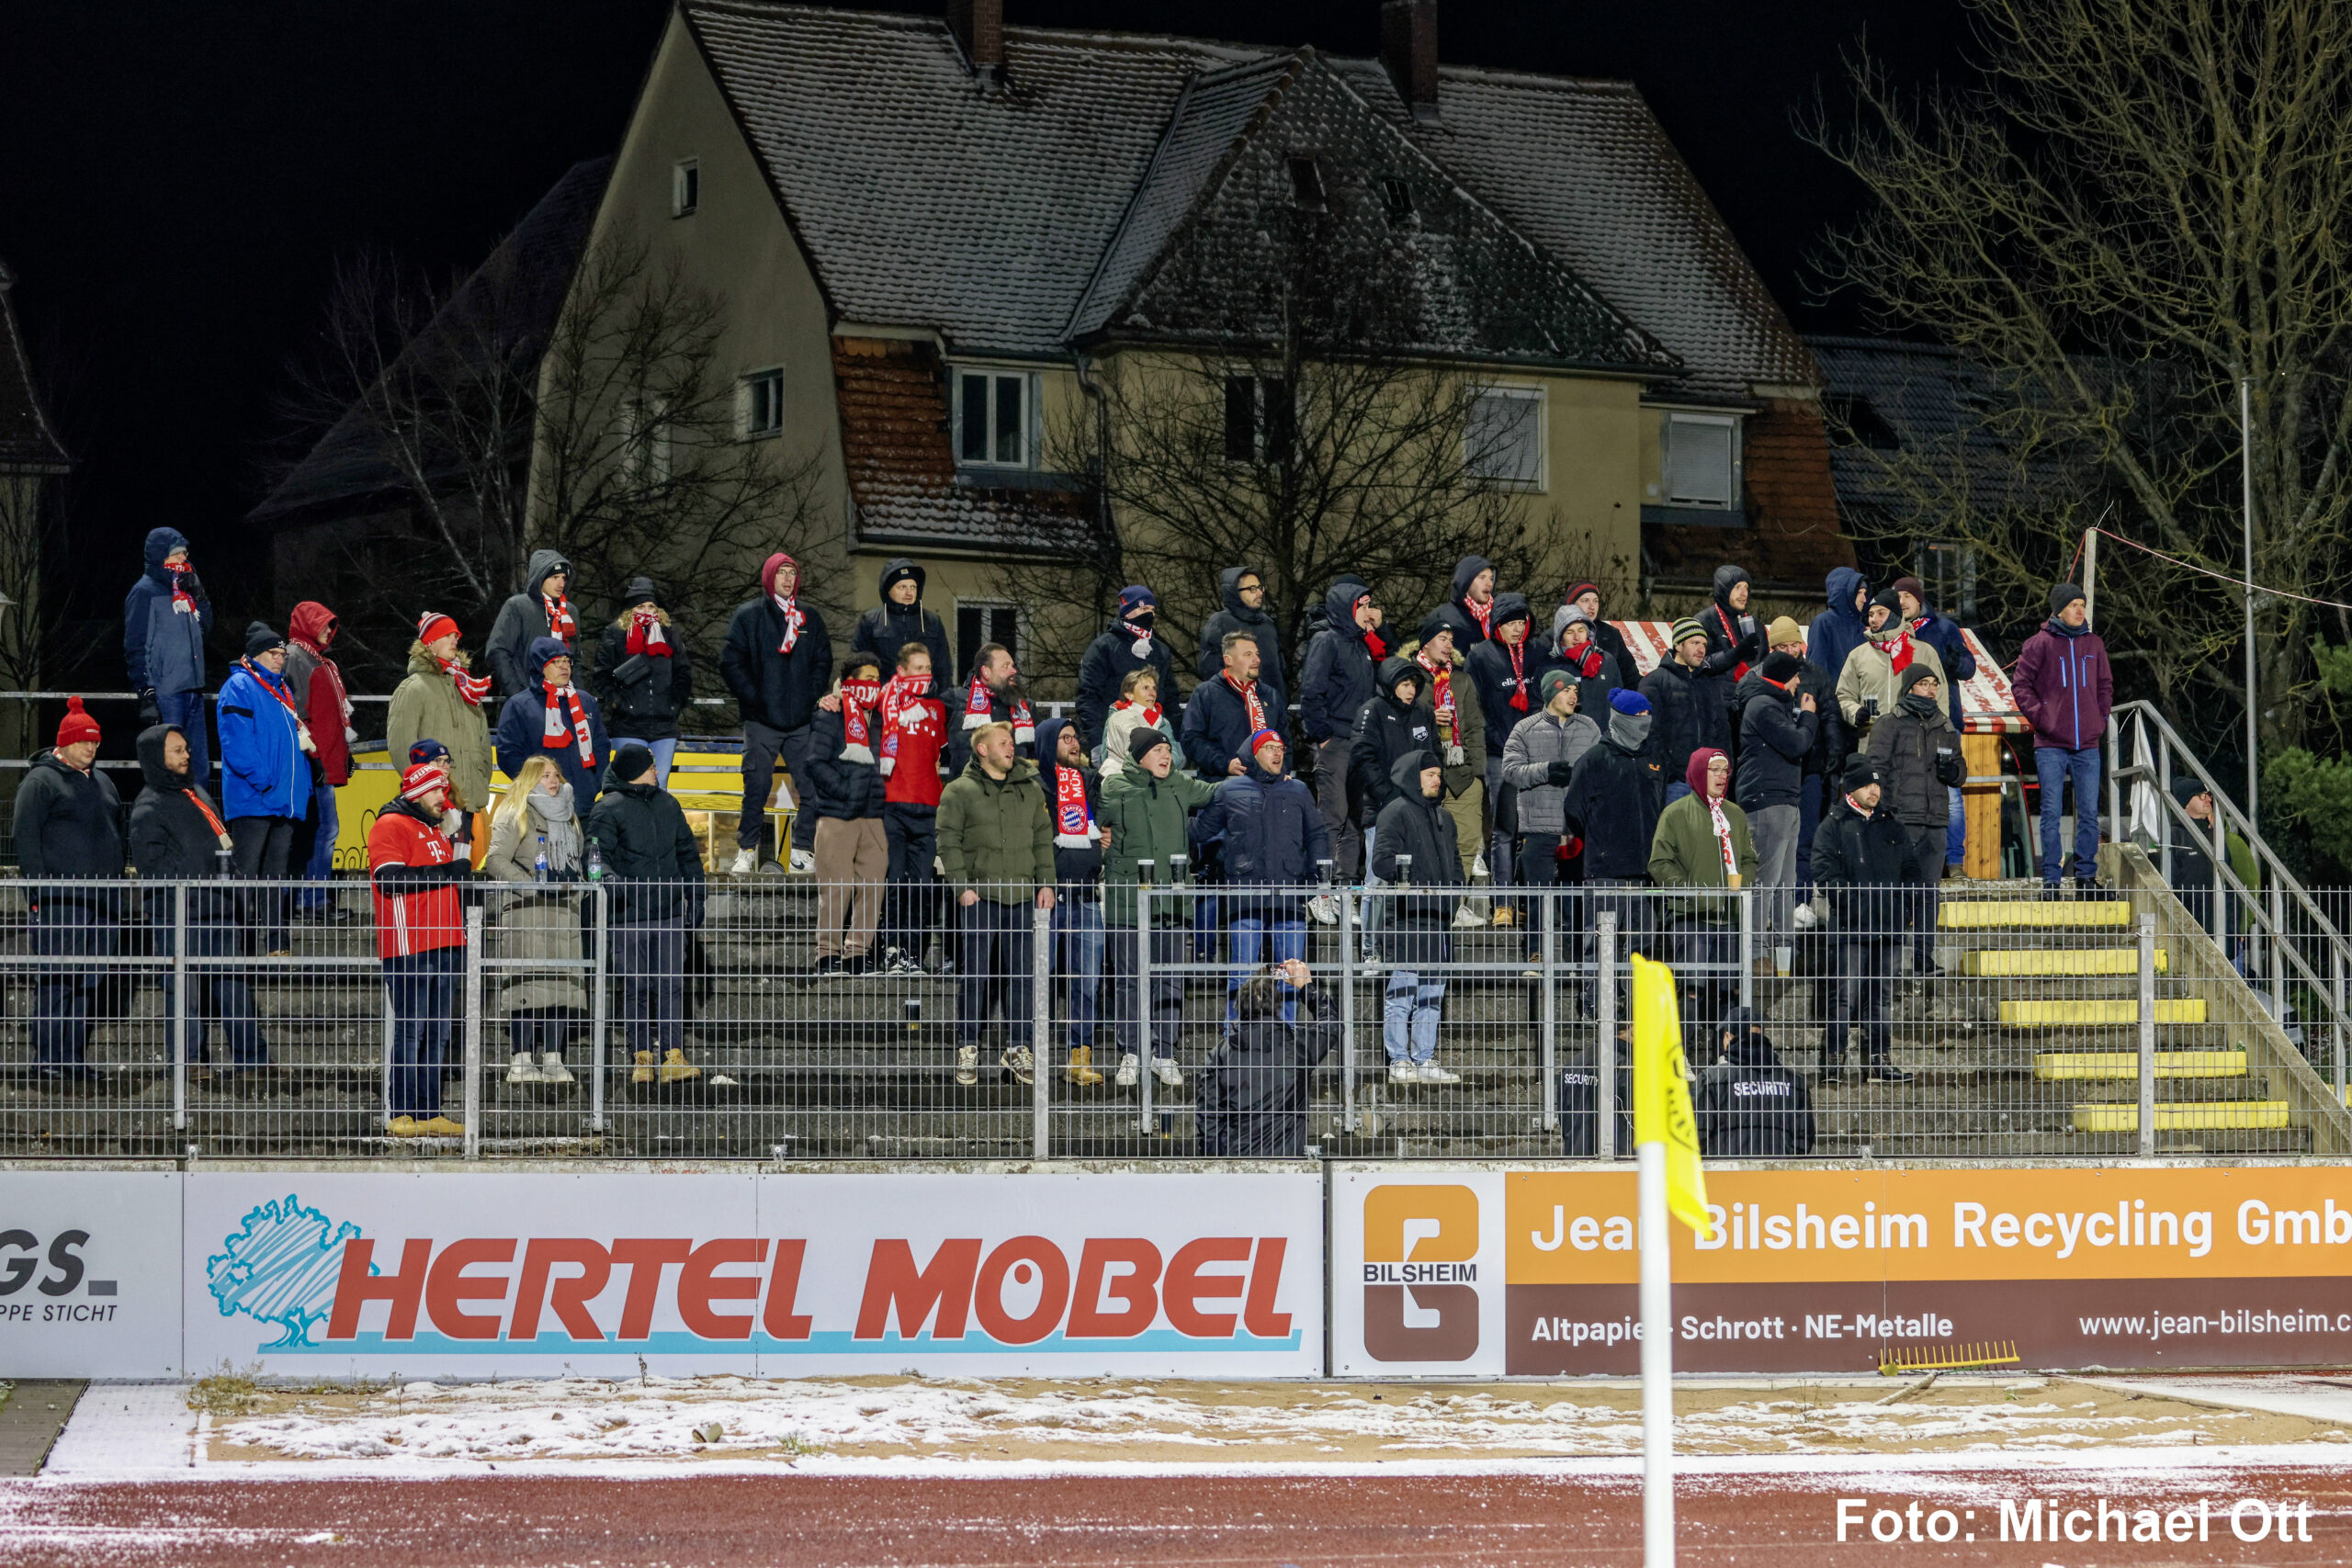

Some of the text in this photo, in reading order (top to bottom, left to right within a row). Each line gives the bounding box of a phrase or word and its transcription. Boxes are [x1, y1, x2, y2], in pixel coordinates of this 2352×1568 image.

[1501, 677, 1531, 687] ellee
[1058, 784, 1070, 802] FC
[1564, 1073, 1599, 1087] SECURITY
[1734, 1081, 1791, 1097] SECURITY
[1531, 1198, 2352, 1259] Jea Bilsheim Recycling Gmb
[1363, 1264, 1477, 1283] BILSHEIM
[327, 1237, 813, 1340] HERTEL
[43, 1304, 118, 1322] STICHT
[1680, 1315, 1784, 1340] Schrott
[1804, 1313, 1954, 1338] NE-Metalle
